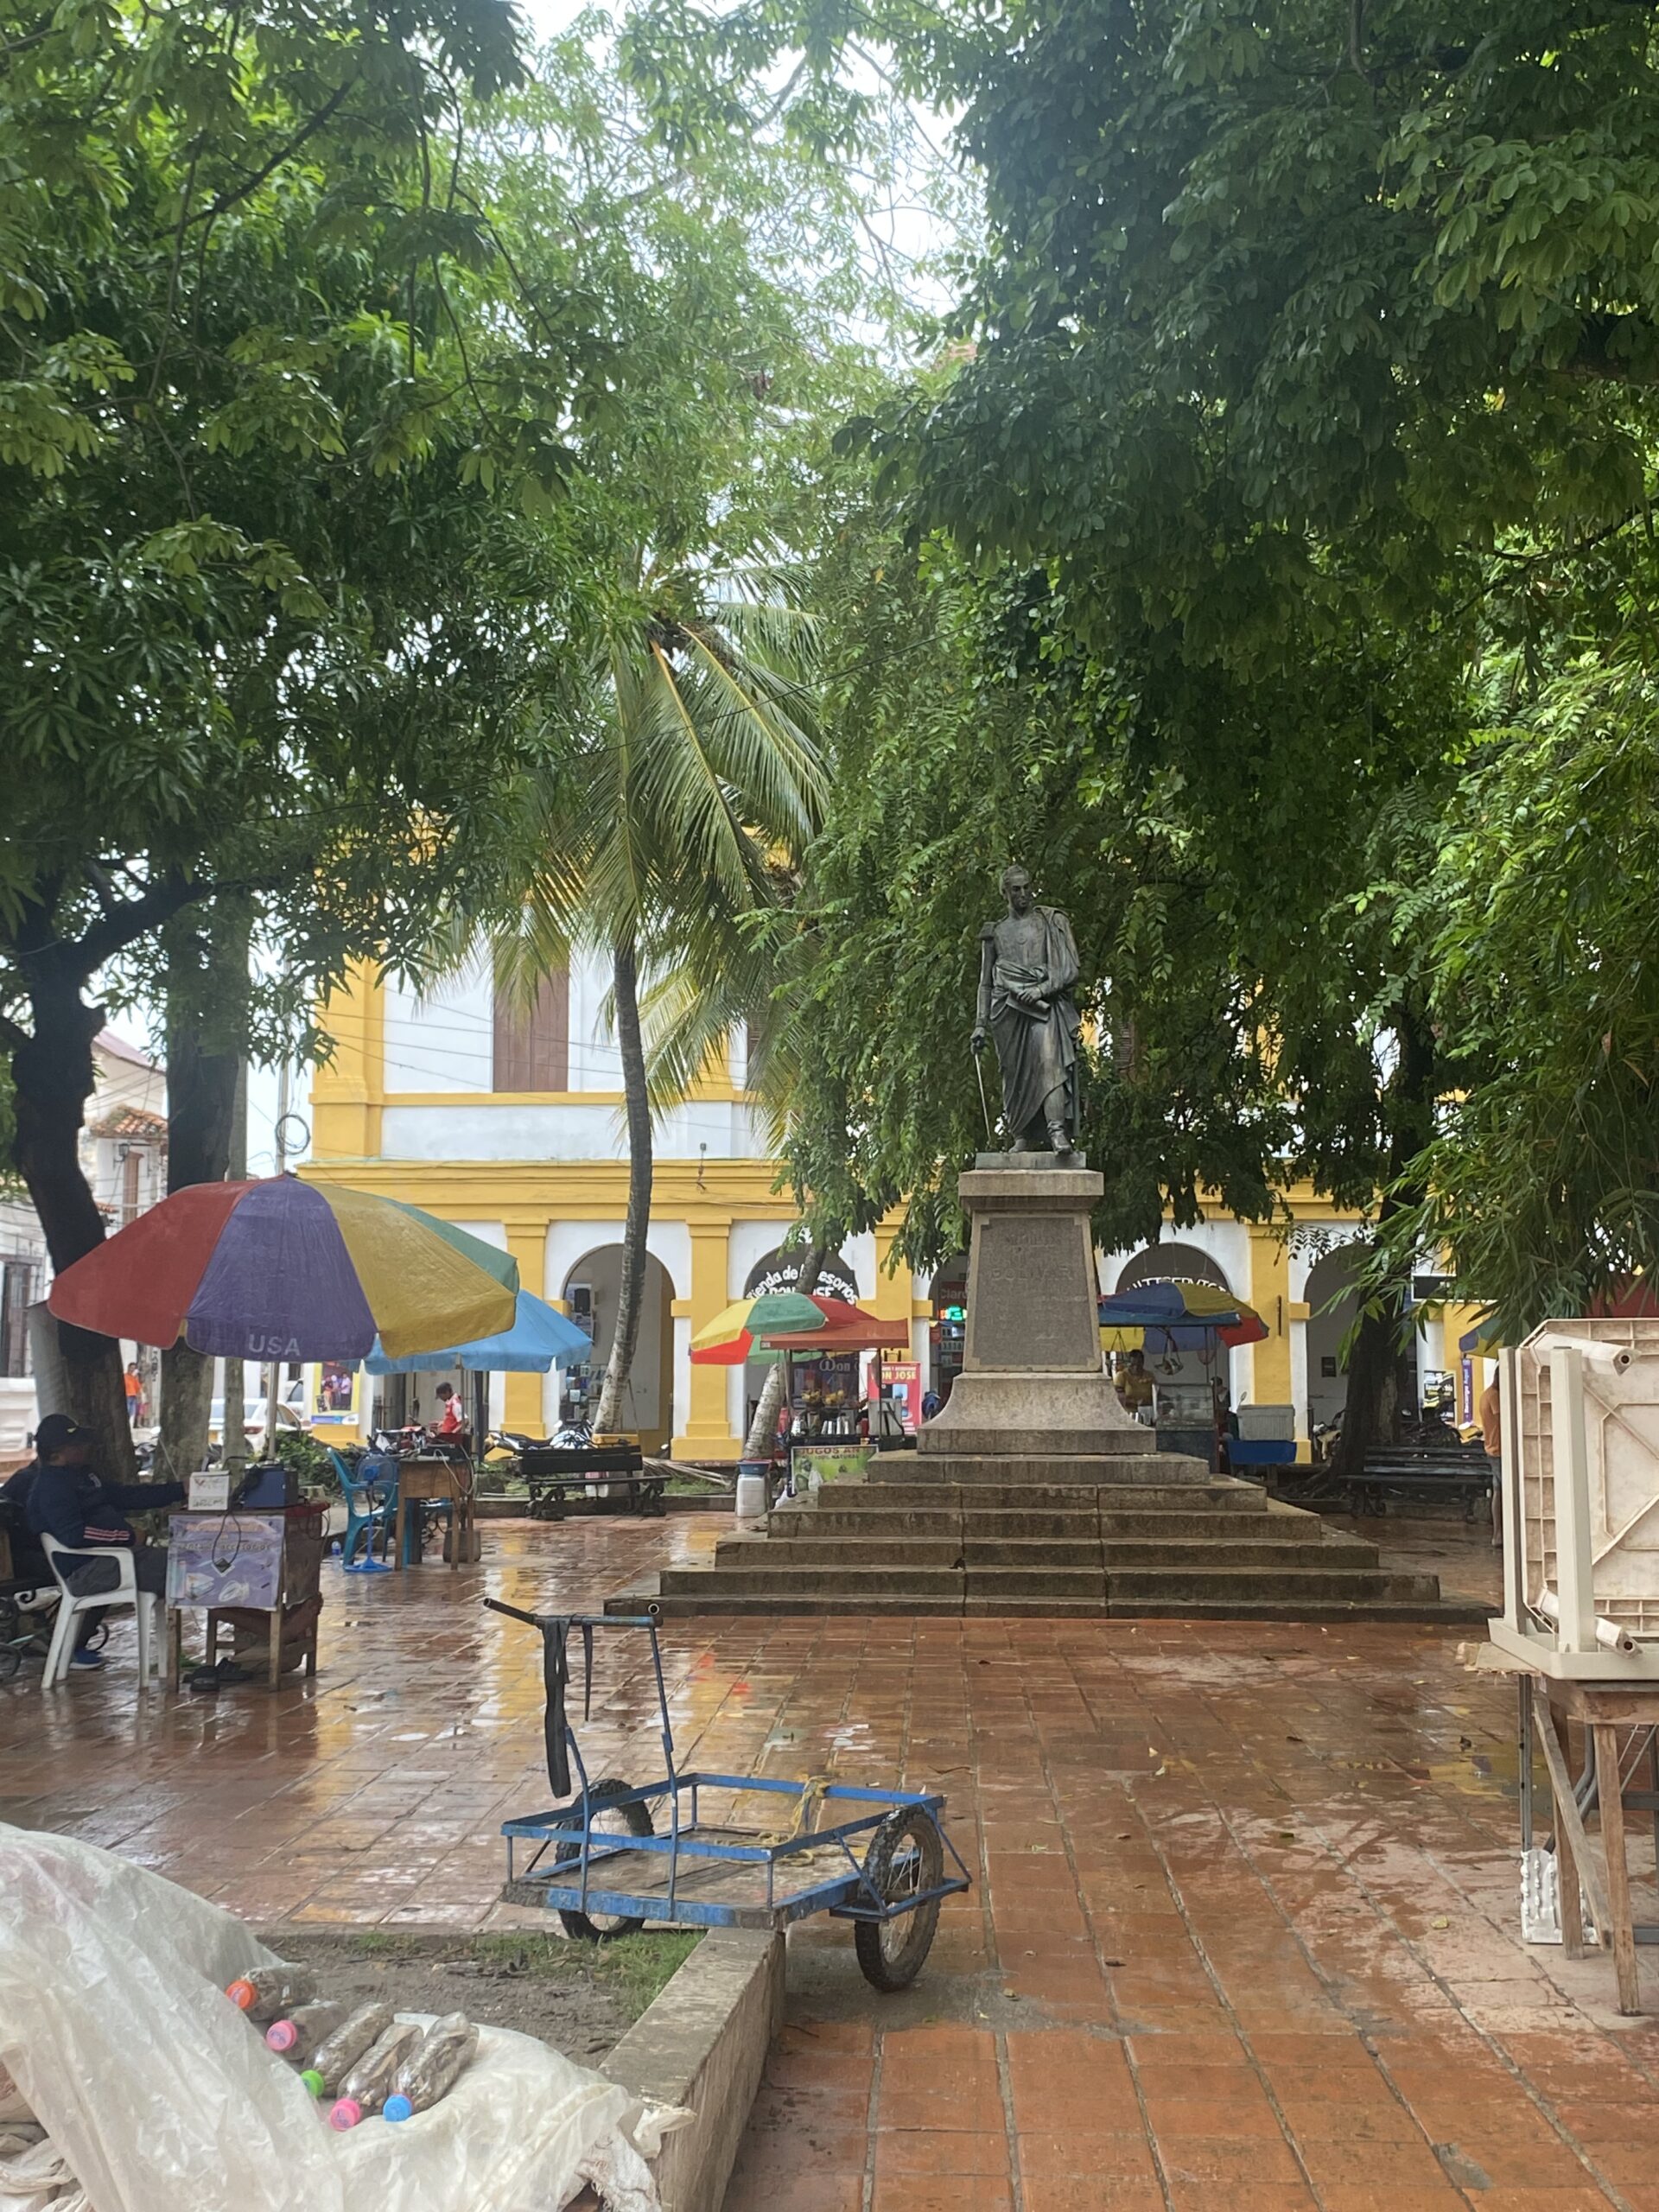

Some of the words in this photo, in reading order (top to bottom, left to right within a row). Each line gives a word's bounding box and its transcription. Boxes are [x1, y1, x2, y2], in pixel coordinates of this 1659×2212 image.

[746, 1272, 782, 1300] Tienda
[782, 1265, 798, 1281] de
[248, 1334, 301, 1357] USA
[800, 1446, 839, 1455] JUGOS
